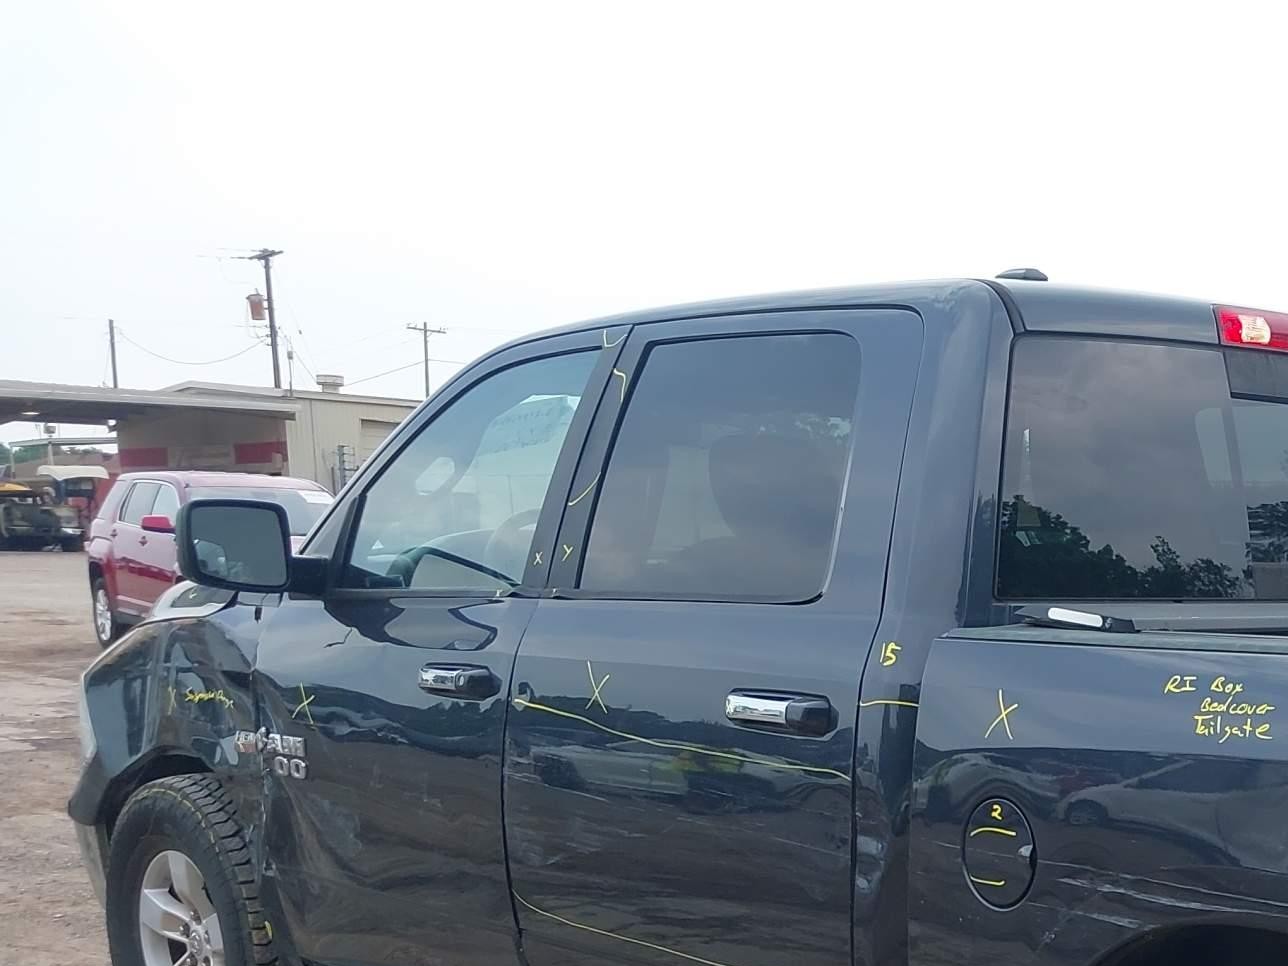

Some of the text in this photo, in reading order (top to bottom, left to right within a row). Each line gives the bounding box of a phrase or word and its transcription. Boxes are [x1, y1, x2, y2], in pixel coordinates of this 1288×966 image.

[879, 641, 902, 666] 15
[1210, 676, 1243, 694] Box
[1193, 715, 1273, 744] Tailgate
[991, 804, 1003, 821] 2
